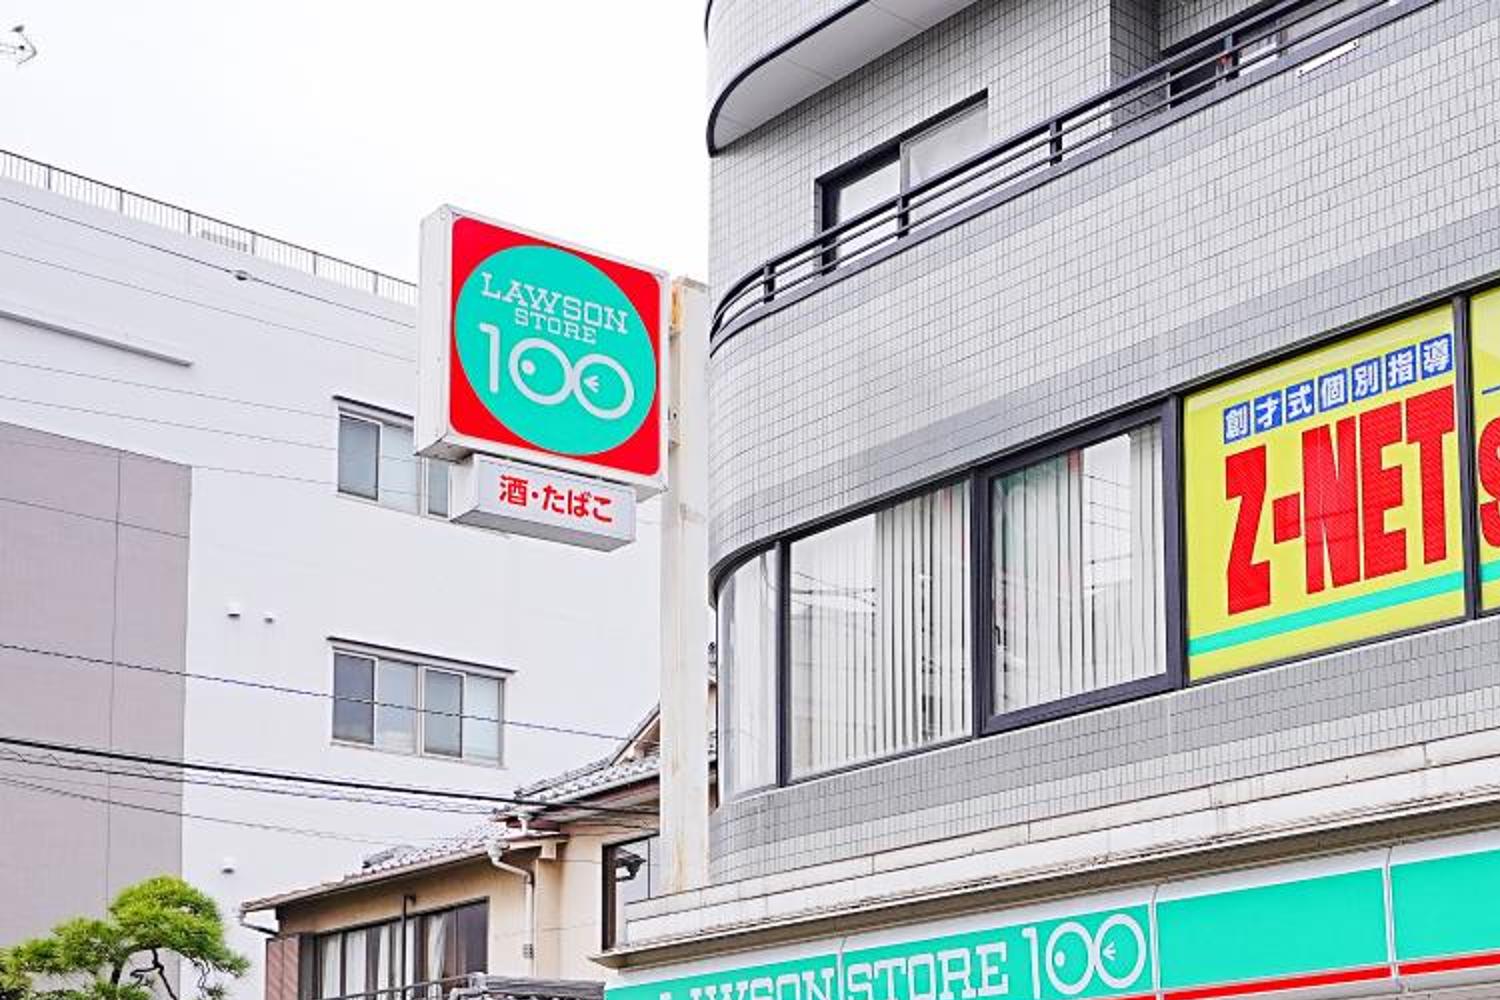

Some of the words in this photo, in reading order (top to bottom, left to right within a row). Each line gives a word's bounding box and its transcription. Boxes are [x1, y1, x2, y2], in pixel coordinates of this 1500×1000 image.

[480, 271, 630, 336] LAWSON
[514, 306, 598, 346] STORE
[478, 322, 636, 422] 100
[1224, 336, 1452, 441] 創才式個別指導
[498, 474, 614, 524] 酒・たばこ
[1225, 383, 1455, 617] Z-NET
[1021, 912, 1148, 1000] 100
